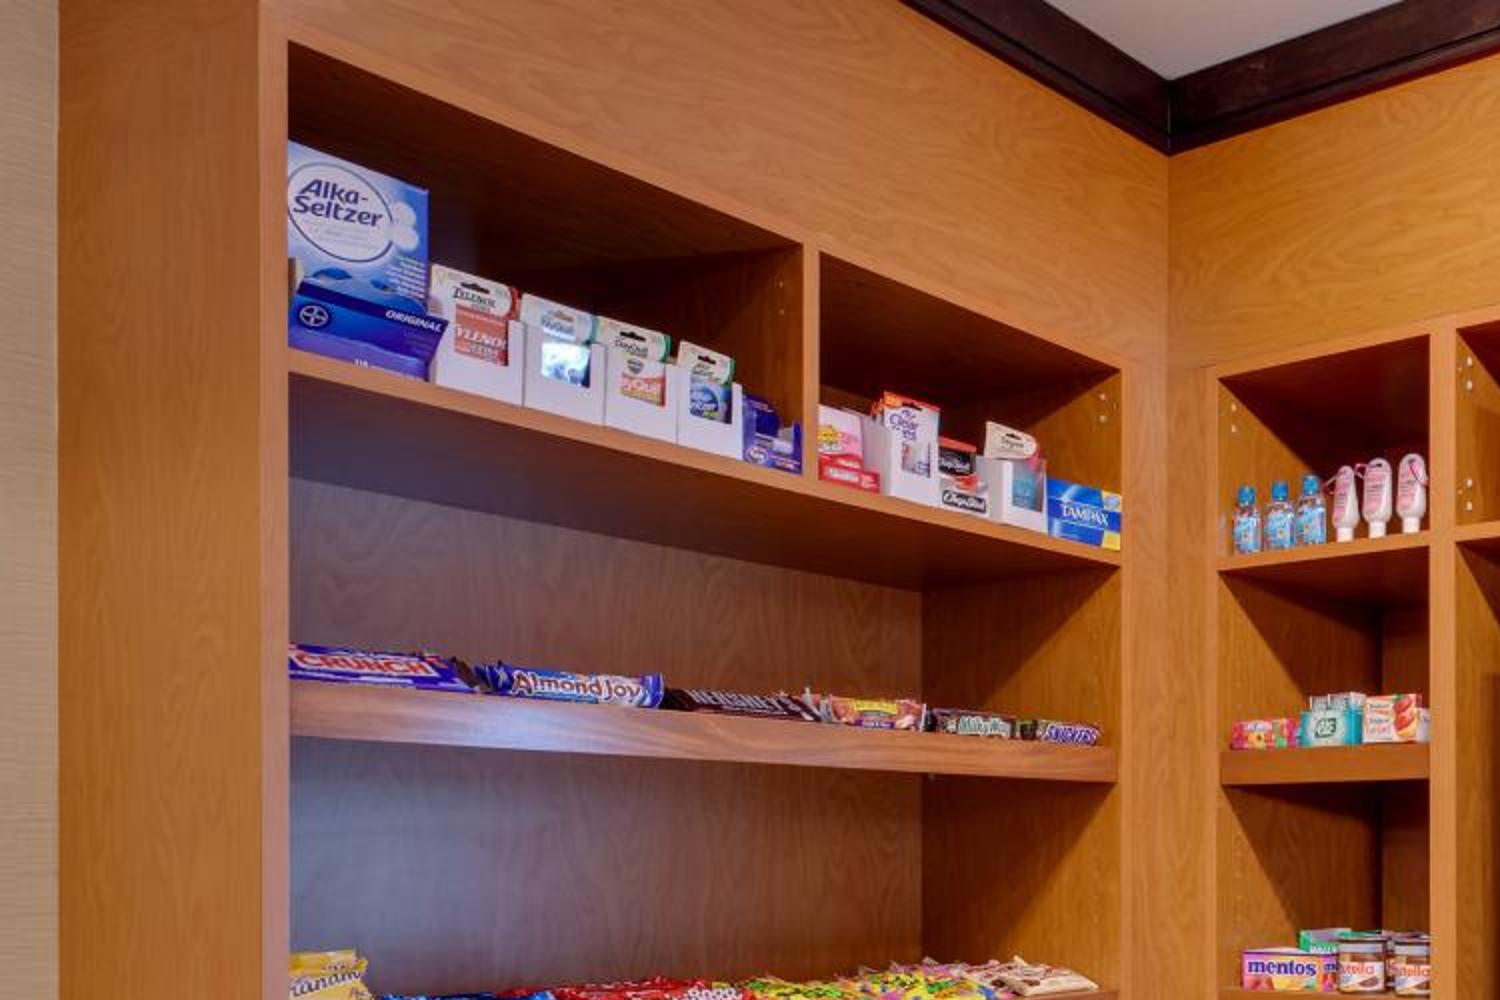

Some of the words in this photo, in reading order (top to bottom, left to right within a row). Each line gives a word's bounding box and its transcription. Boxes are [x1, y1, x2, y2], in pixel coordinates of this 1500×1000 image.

[301, 177, 368, 206] Alka-
[293, 194, 384, 228] Seltzer
[453, 286, 497, 308] TYLENOL
[385, 309, 444, 334] ORIGINAL
[1062, 503, 1109, 528] TAMPAX
[301, 653, 431, 676] CRUNCH
[513, 669, 600, 698] Almond
[603, 677, 645, 705] Joy
[1043, 725, 1097, 745] SNICKERS
[1248, 958, 1318, 977] mentos
